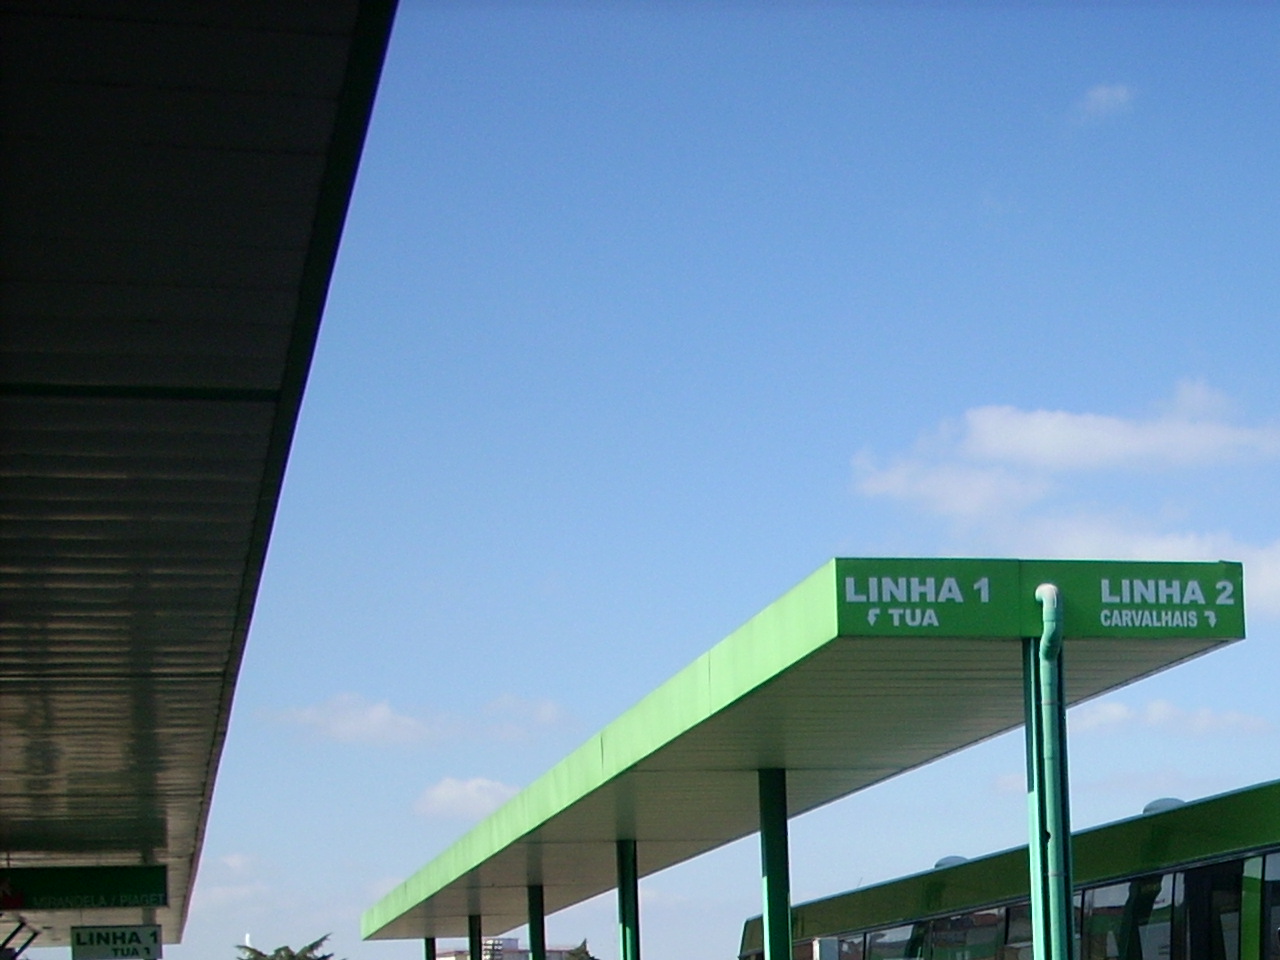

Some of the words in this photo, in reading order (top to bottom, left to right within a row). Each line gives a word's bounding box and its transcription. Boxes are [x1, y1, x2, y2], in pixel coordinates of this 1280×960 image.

[845, 577, 963, 603] LINHA
[973, 578, 990, 602] 1
[1101, 579, 1205, 605] LINHA
[1216, 581, 1235, 605] 2
[888, 609, 939, 627] TUA
[1100, 609, 1198, 628] CARVALHAIS
[76, 931, 141, 946] LINHA
[149, 930, 158, 944] 1
[113, 947, 139, 957] TUA
